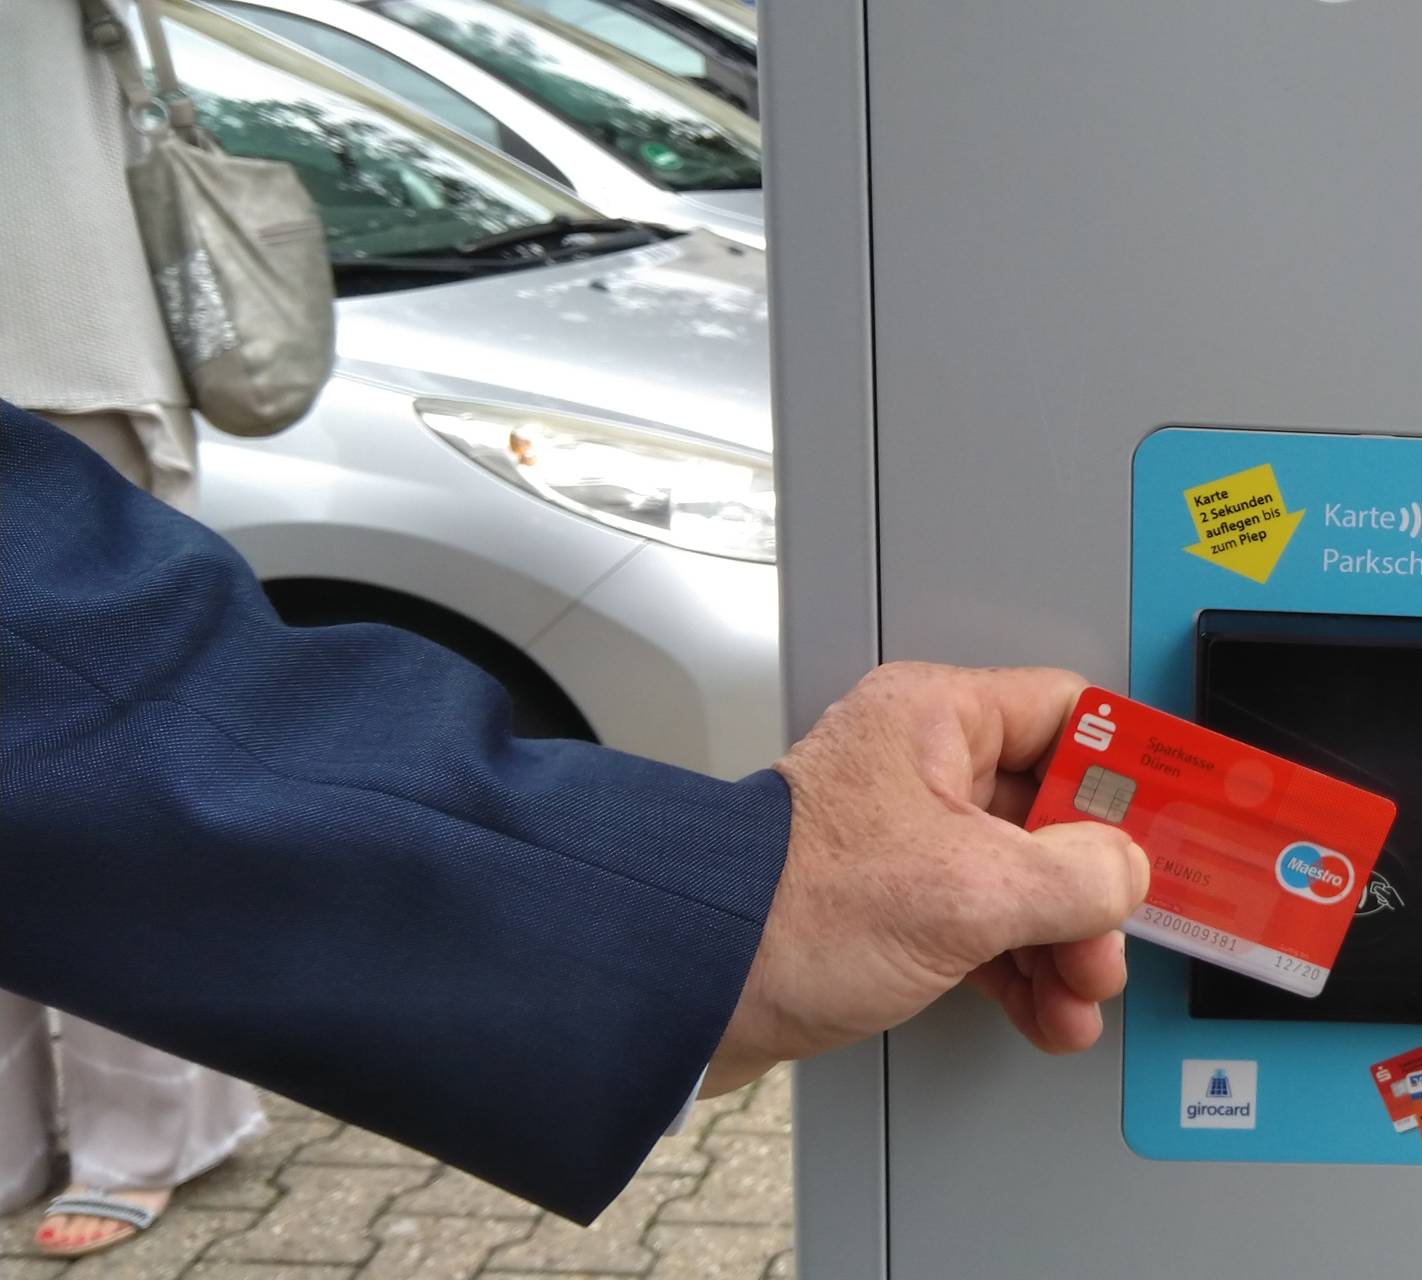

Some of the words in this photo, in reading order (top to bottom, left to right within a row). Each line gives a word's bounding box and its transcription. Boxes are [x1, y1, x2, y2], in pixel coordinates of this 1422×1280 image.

[1193, 489, 1229, 508] Karte
[1199, 512, 1208, 523] 2
[1211, 493, 1274, 520] Sekunden
[1206, 512, 1261, 539] auflegen
[1262, 506, 1282, 522] bis
[1324, 503, 1396, 530] Karte
[1211, 540, 1238, 555] zum
[1240, 528, 1268, 546] Piep
[1140, 754, 1181, 779] Düren
[1146, 736, 1216, 771] Sparkasse
[1287, 856, 1343, 888] Maestro
[1273, 955, 1321, 981] 12/20
[1187, 1102, 1250, 1119] girocard
